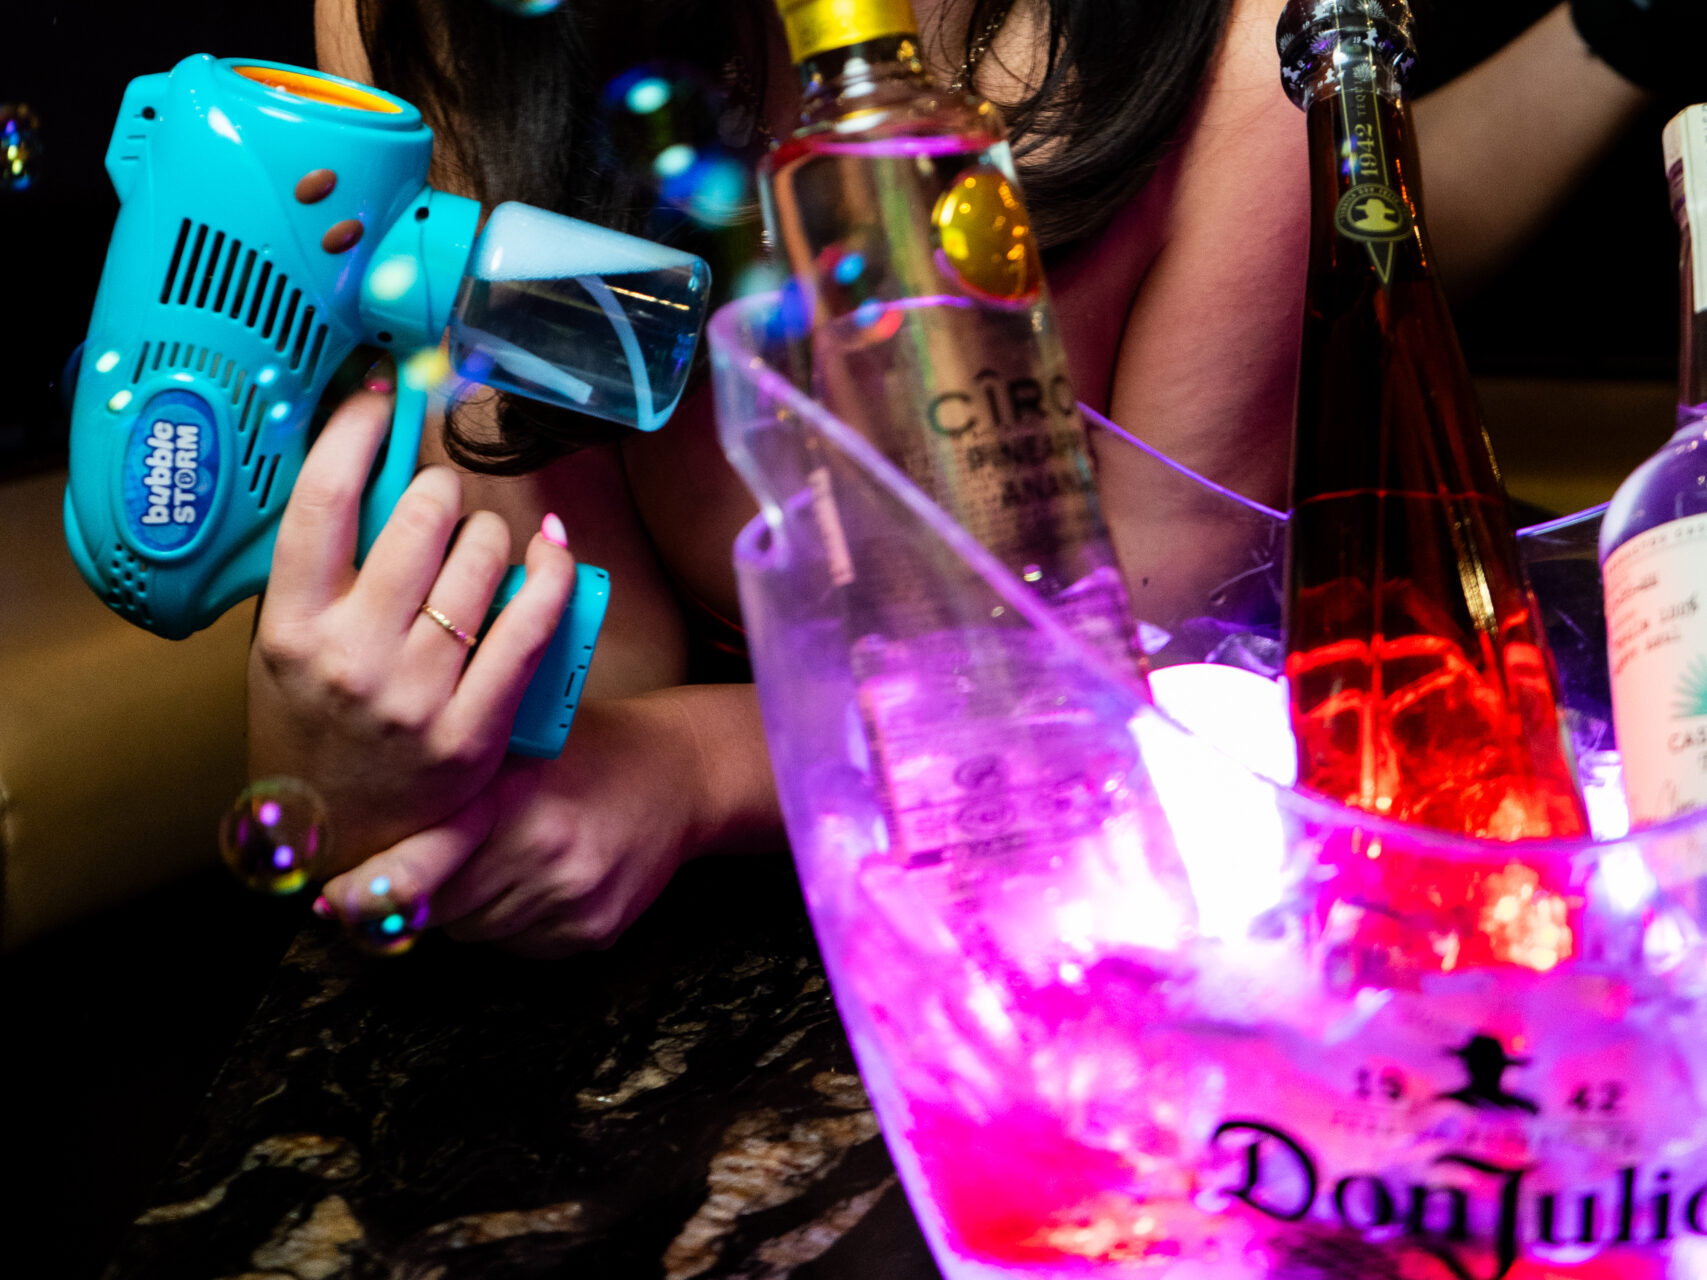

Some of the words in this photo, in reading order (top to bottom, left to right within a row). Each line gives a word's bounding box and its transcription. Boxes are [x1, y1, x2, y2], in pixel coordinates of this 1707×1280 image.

[1356, 122, 1379, 177] 1942
[142, 420, 174, 524] bubble
[1211, 1120, 1468, 1242] Don
